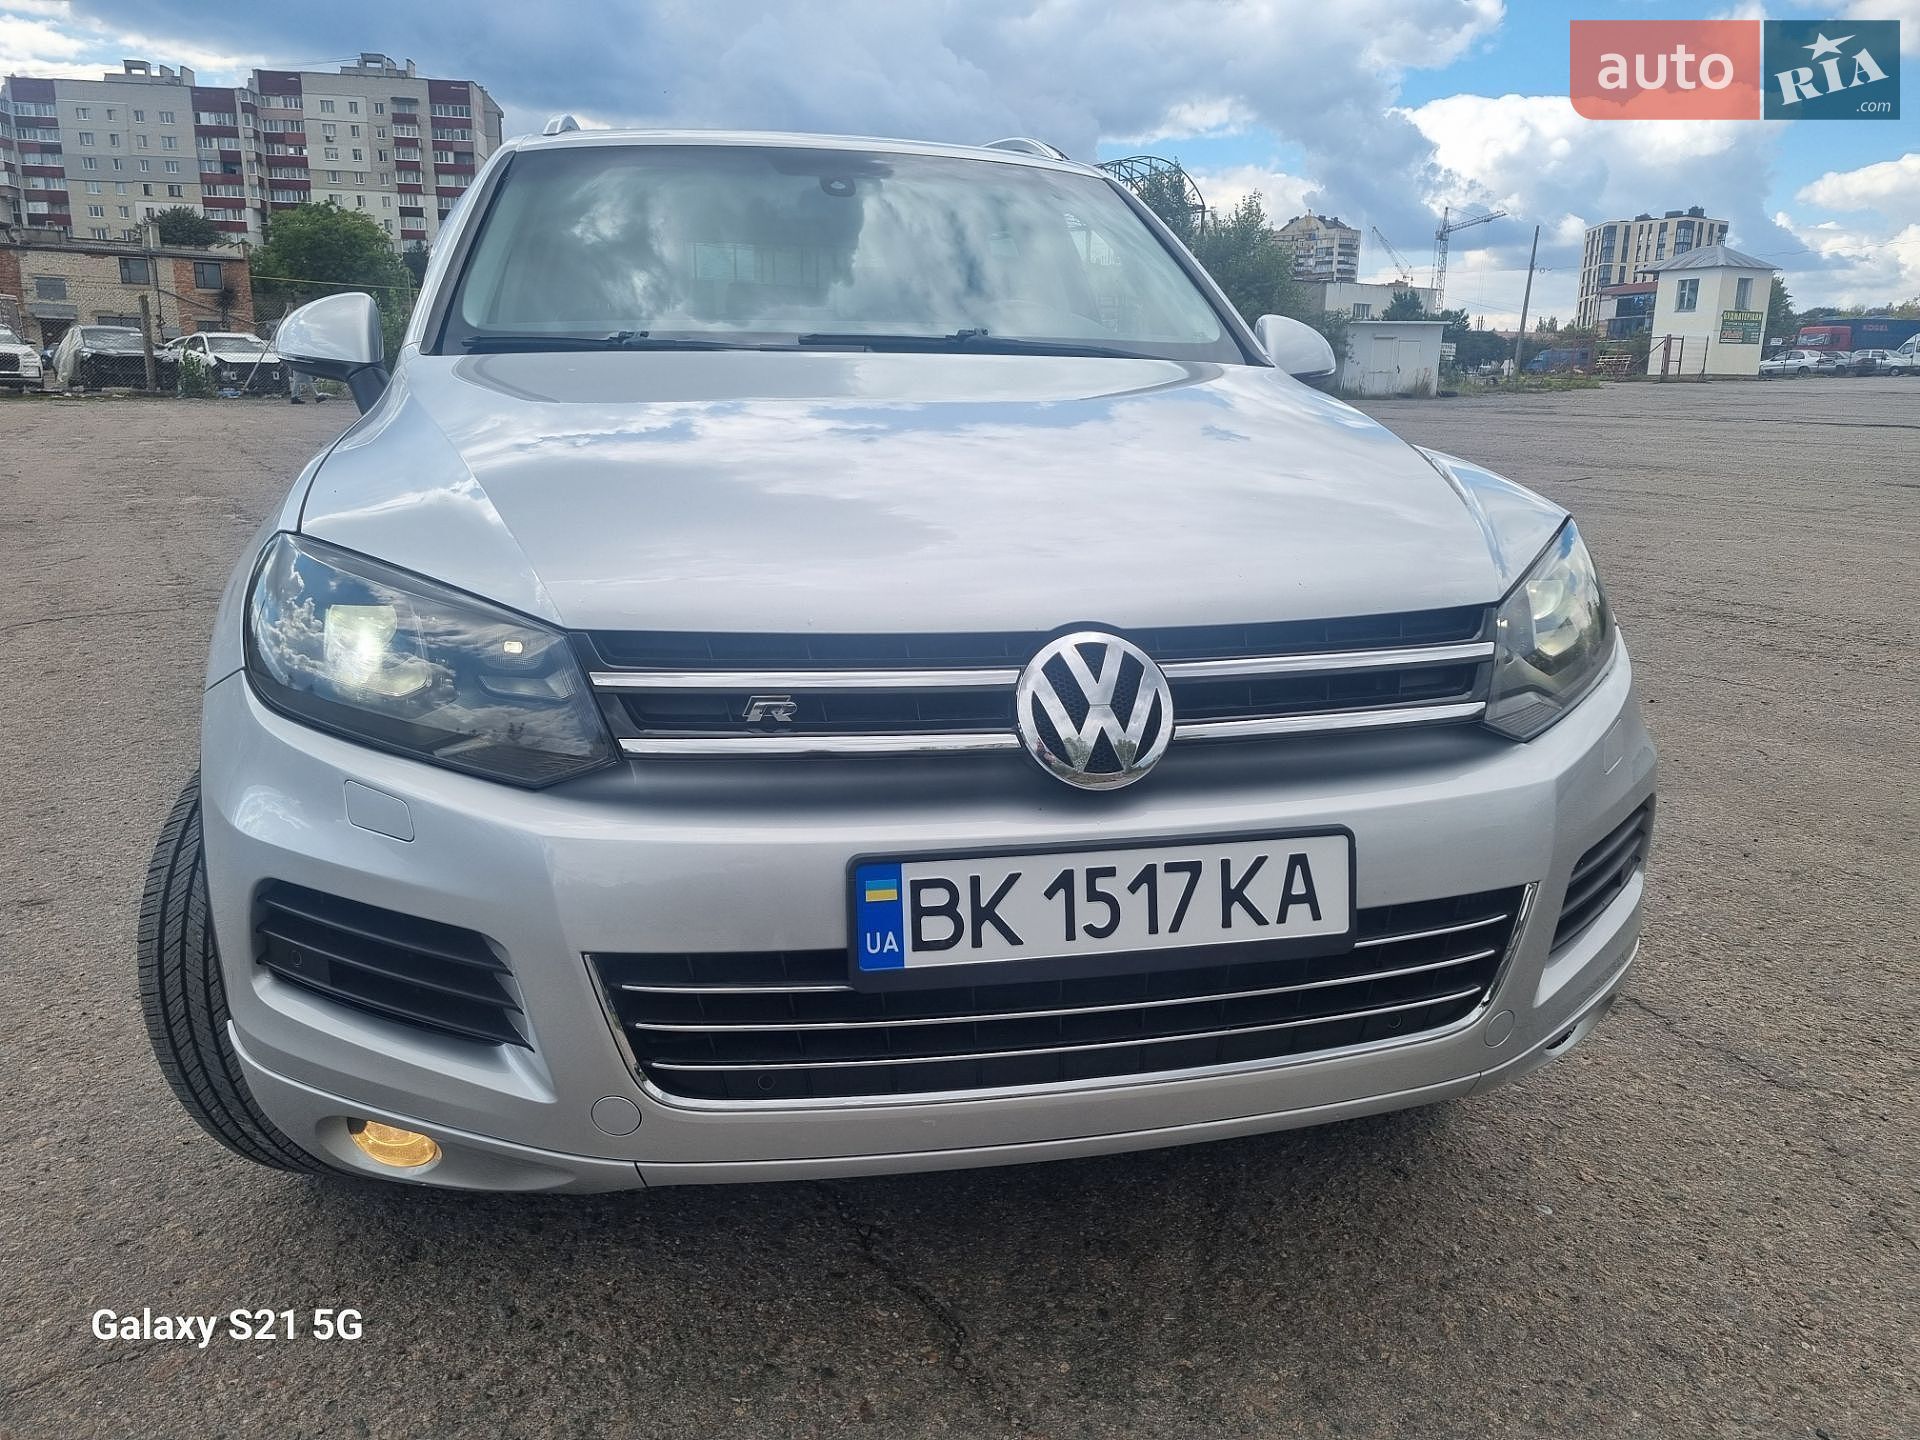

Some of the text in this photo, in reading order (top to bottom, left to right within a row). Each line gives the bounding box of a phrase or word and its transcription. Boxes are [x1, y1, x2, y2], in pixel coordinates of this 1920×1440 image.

[909, 852, 1322, 953] BK 1517 KA
[866, 930, 899, 954] UA
